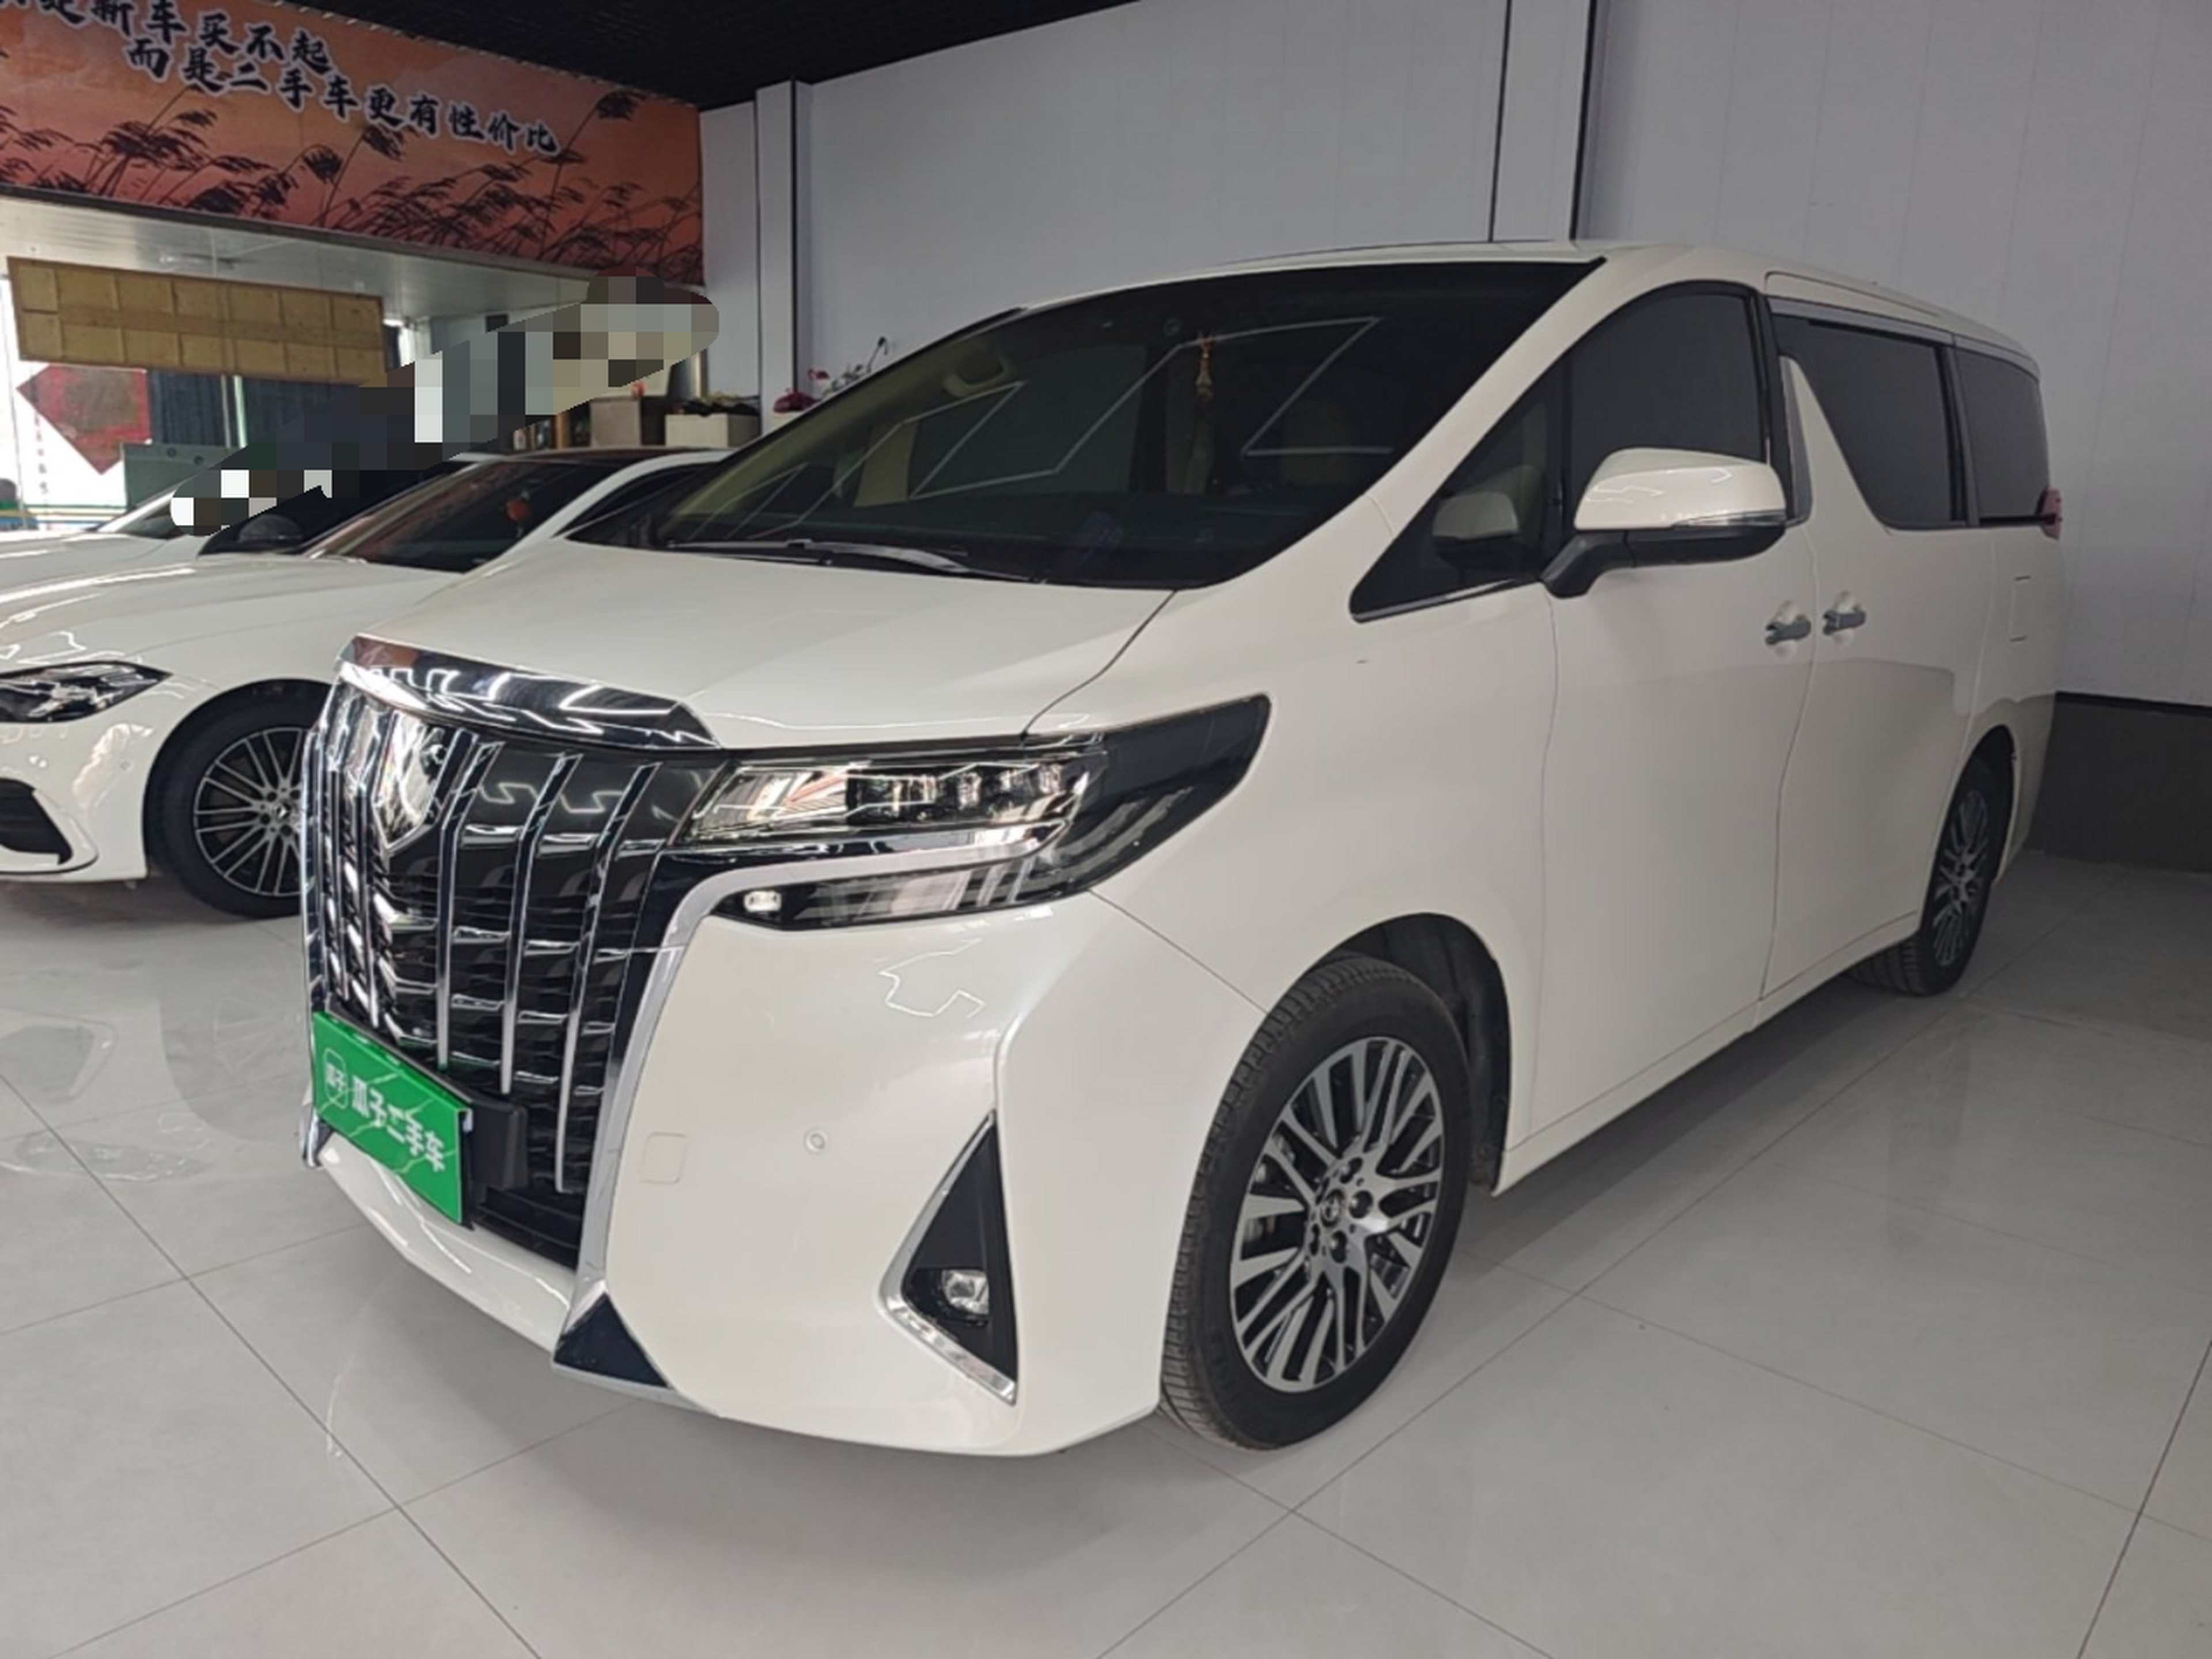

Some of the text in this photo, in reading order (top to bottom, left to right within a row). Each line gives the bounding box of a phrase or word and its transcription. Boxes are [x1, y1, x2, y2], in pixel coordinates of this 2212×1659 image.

[0, 0, 330, 72] 是新车买不起
[128, 39, 558, 153] 而是二手车更有性价比
[352, 1075, 445, 1172] 瓜子二手车
